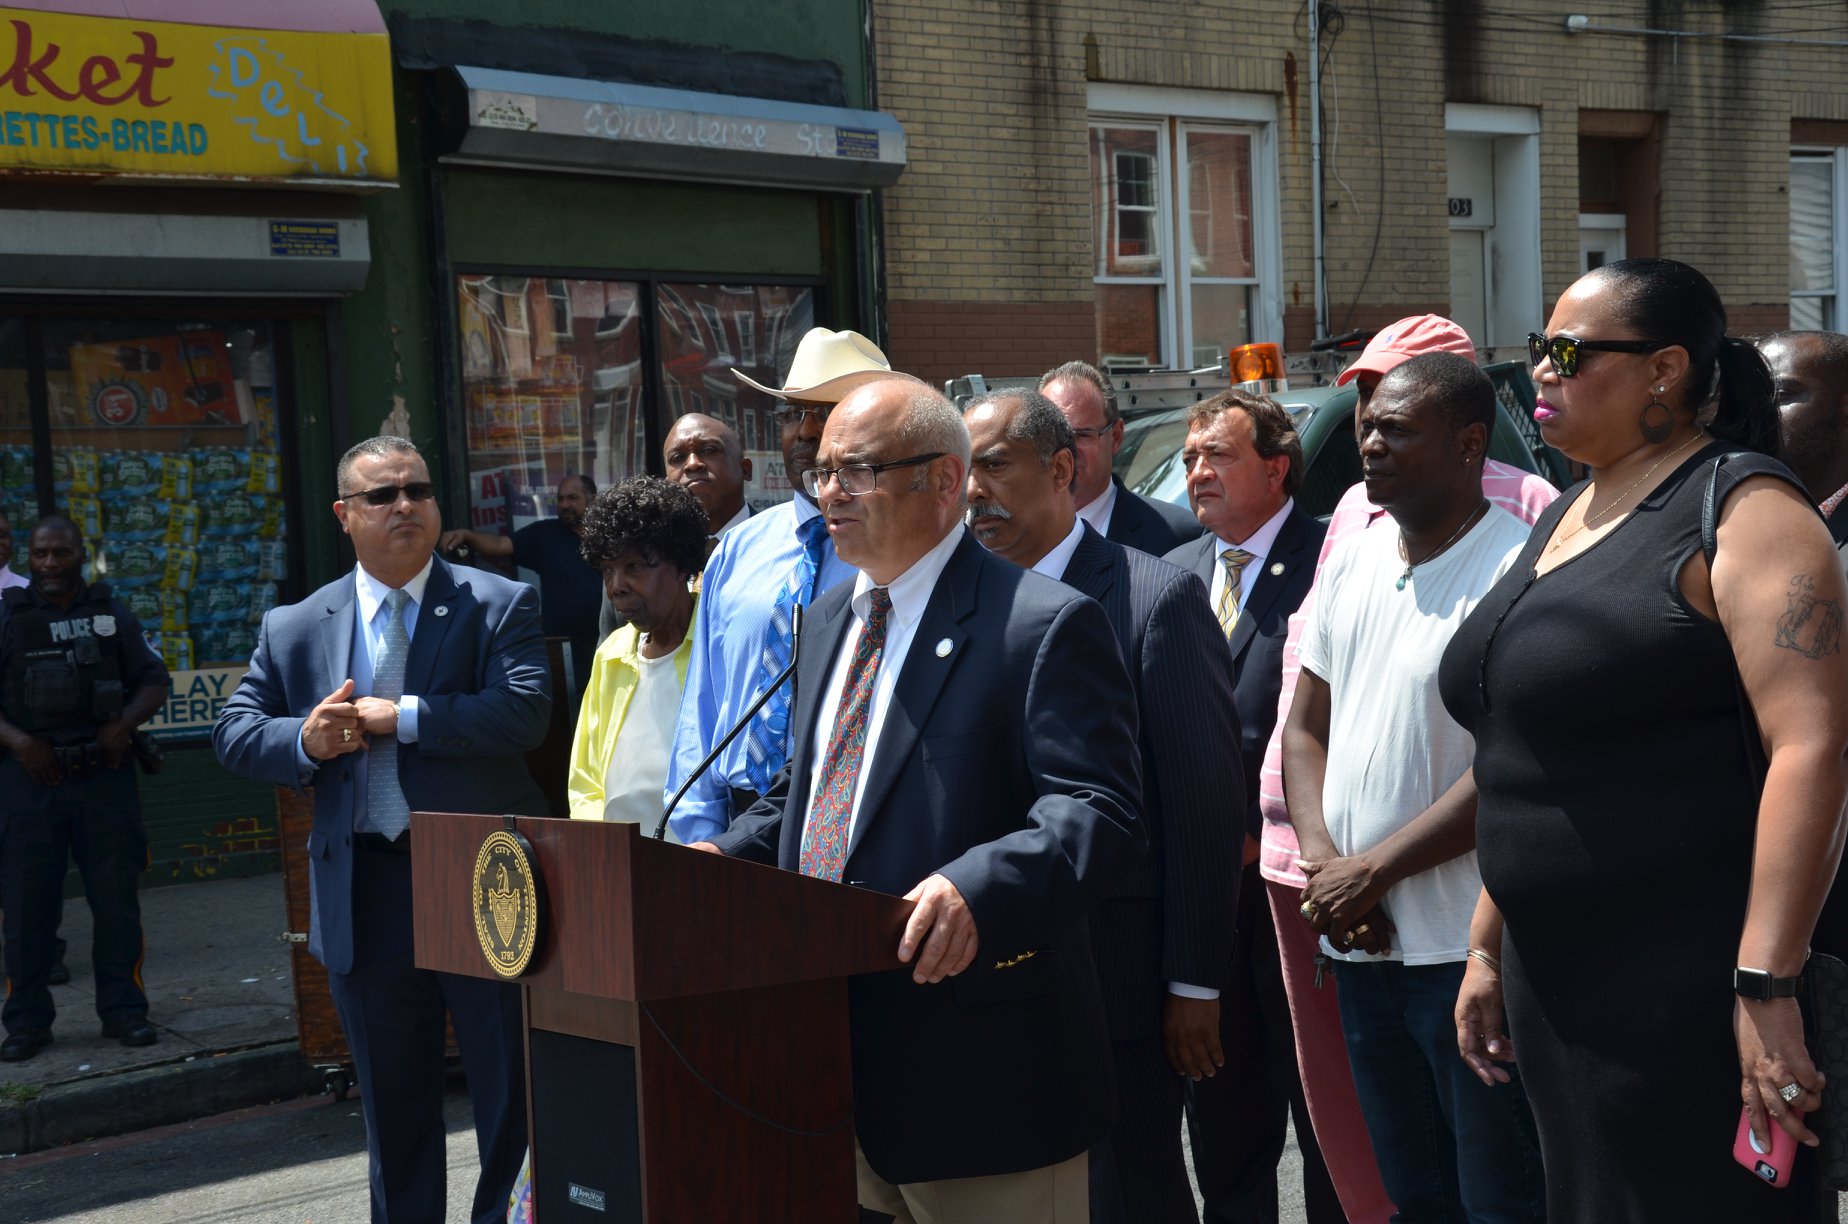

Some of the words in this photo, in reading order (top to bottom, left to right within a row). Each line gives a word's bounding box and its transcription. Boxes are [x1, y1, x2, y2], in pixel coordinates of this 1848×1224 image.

[0, 111, 208, 155] ETTES-BREAD
[49, 618, 93, 643] POLICE
[495, 846, 511, 857] CITY
[501, 951, 515, 960] 1792
